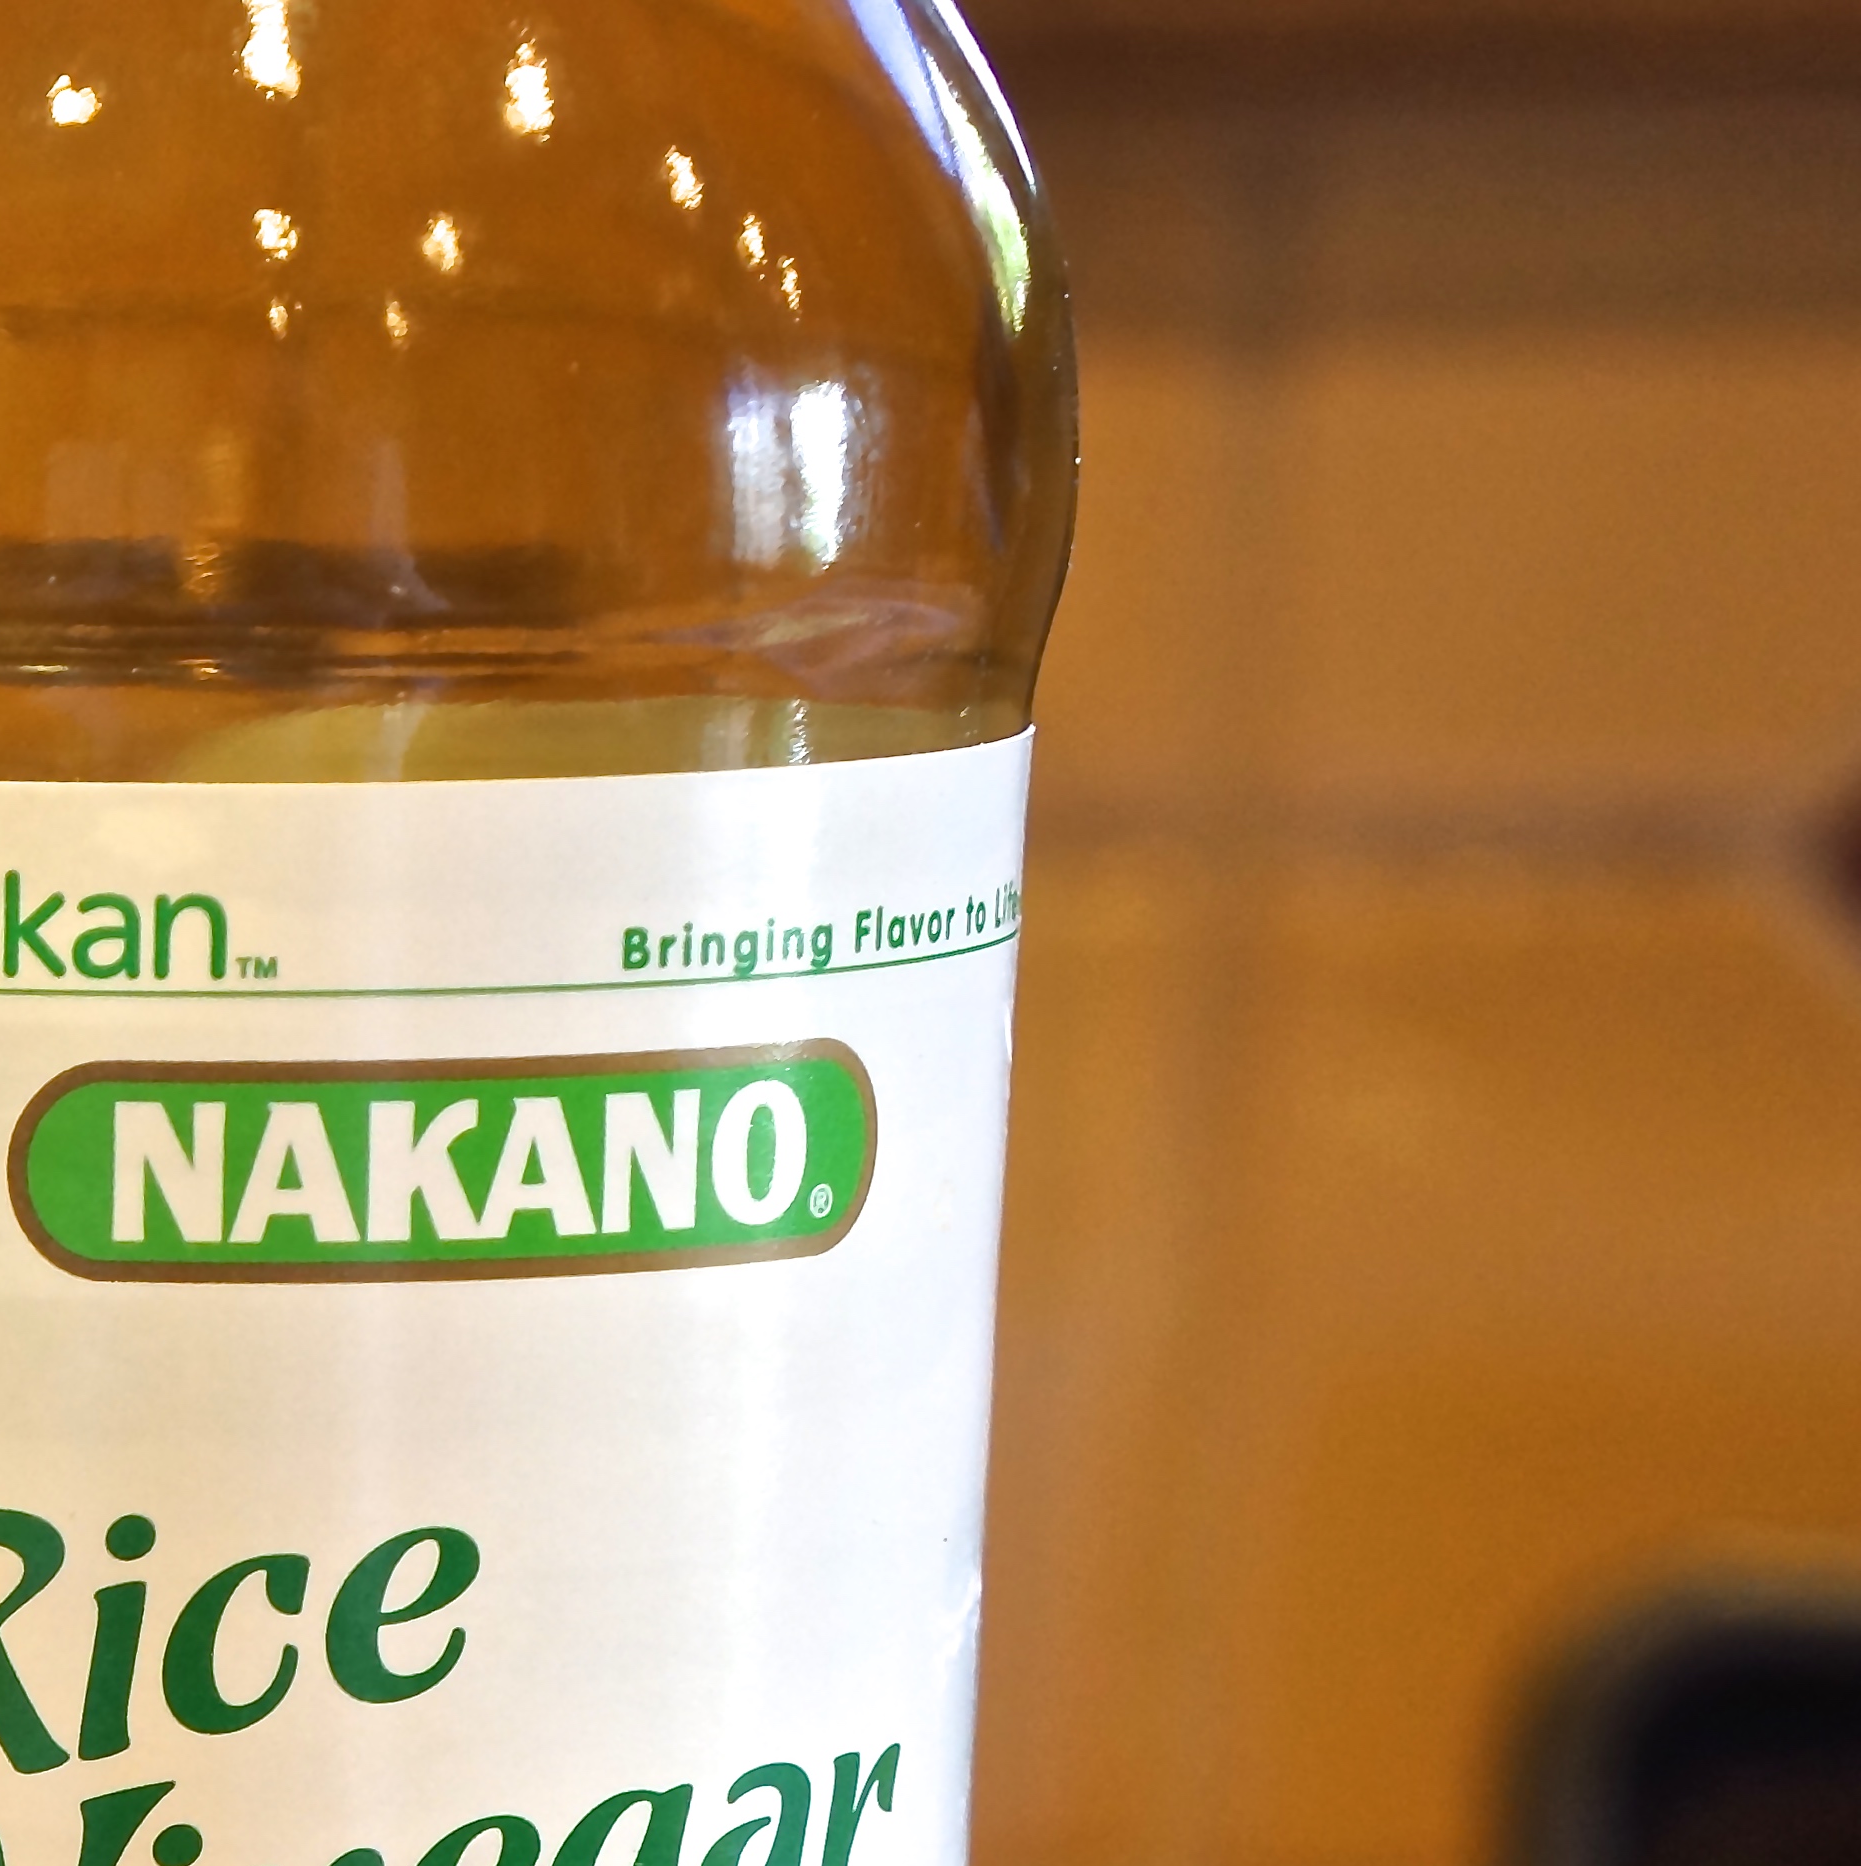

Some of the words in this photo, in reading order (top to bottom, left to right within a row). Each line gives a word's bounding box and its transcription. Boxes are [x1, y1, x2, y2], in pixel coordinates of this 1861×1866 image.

[622, 917, 833, 979] Bringing
[855, 906, 955, 953] Flavor
[967, 895, 986, 936] to
[111, 1080, 807, 1245] NAKANO
